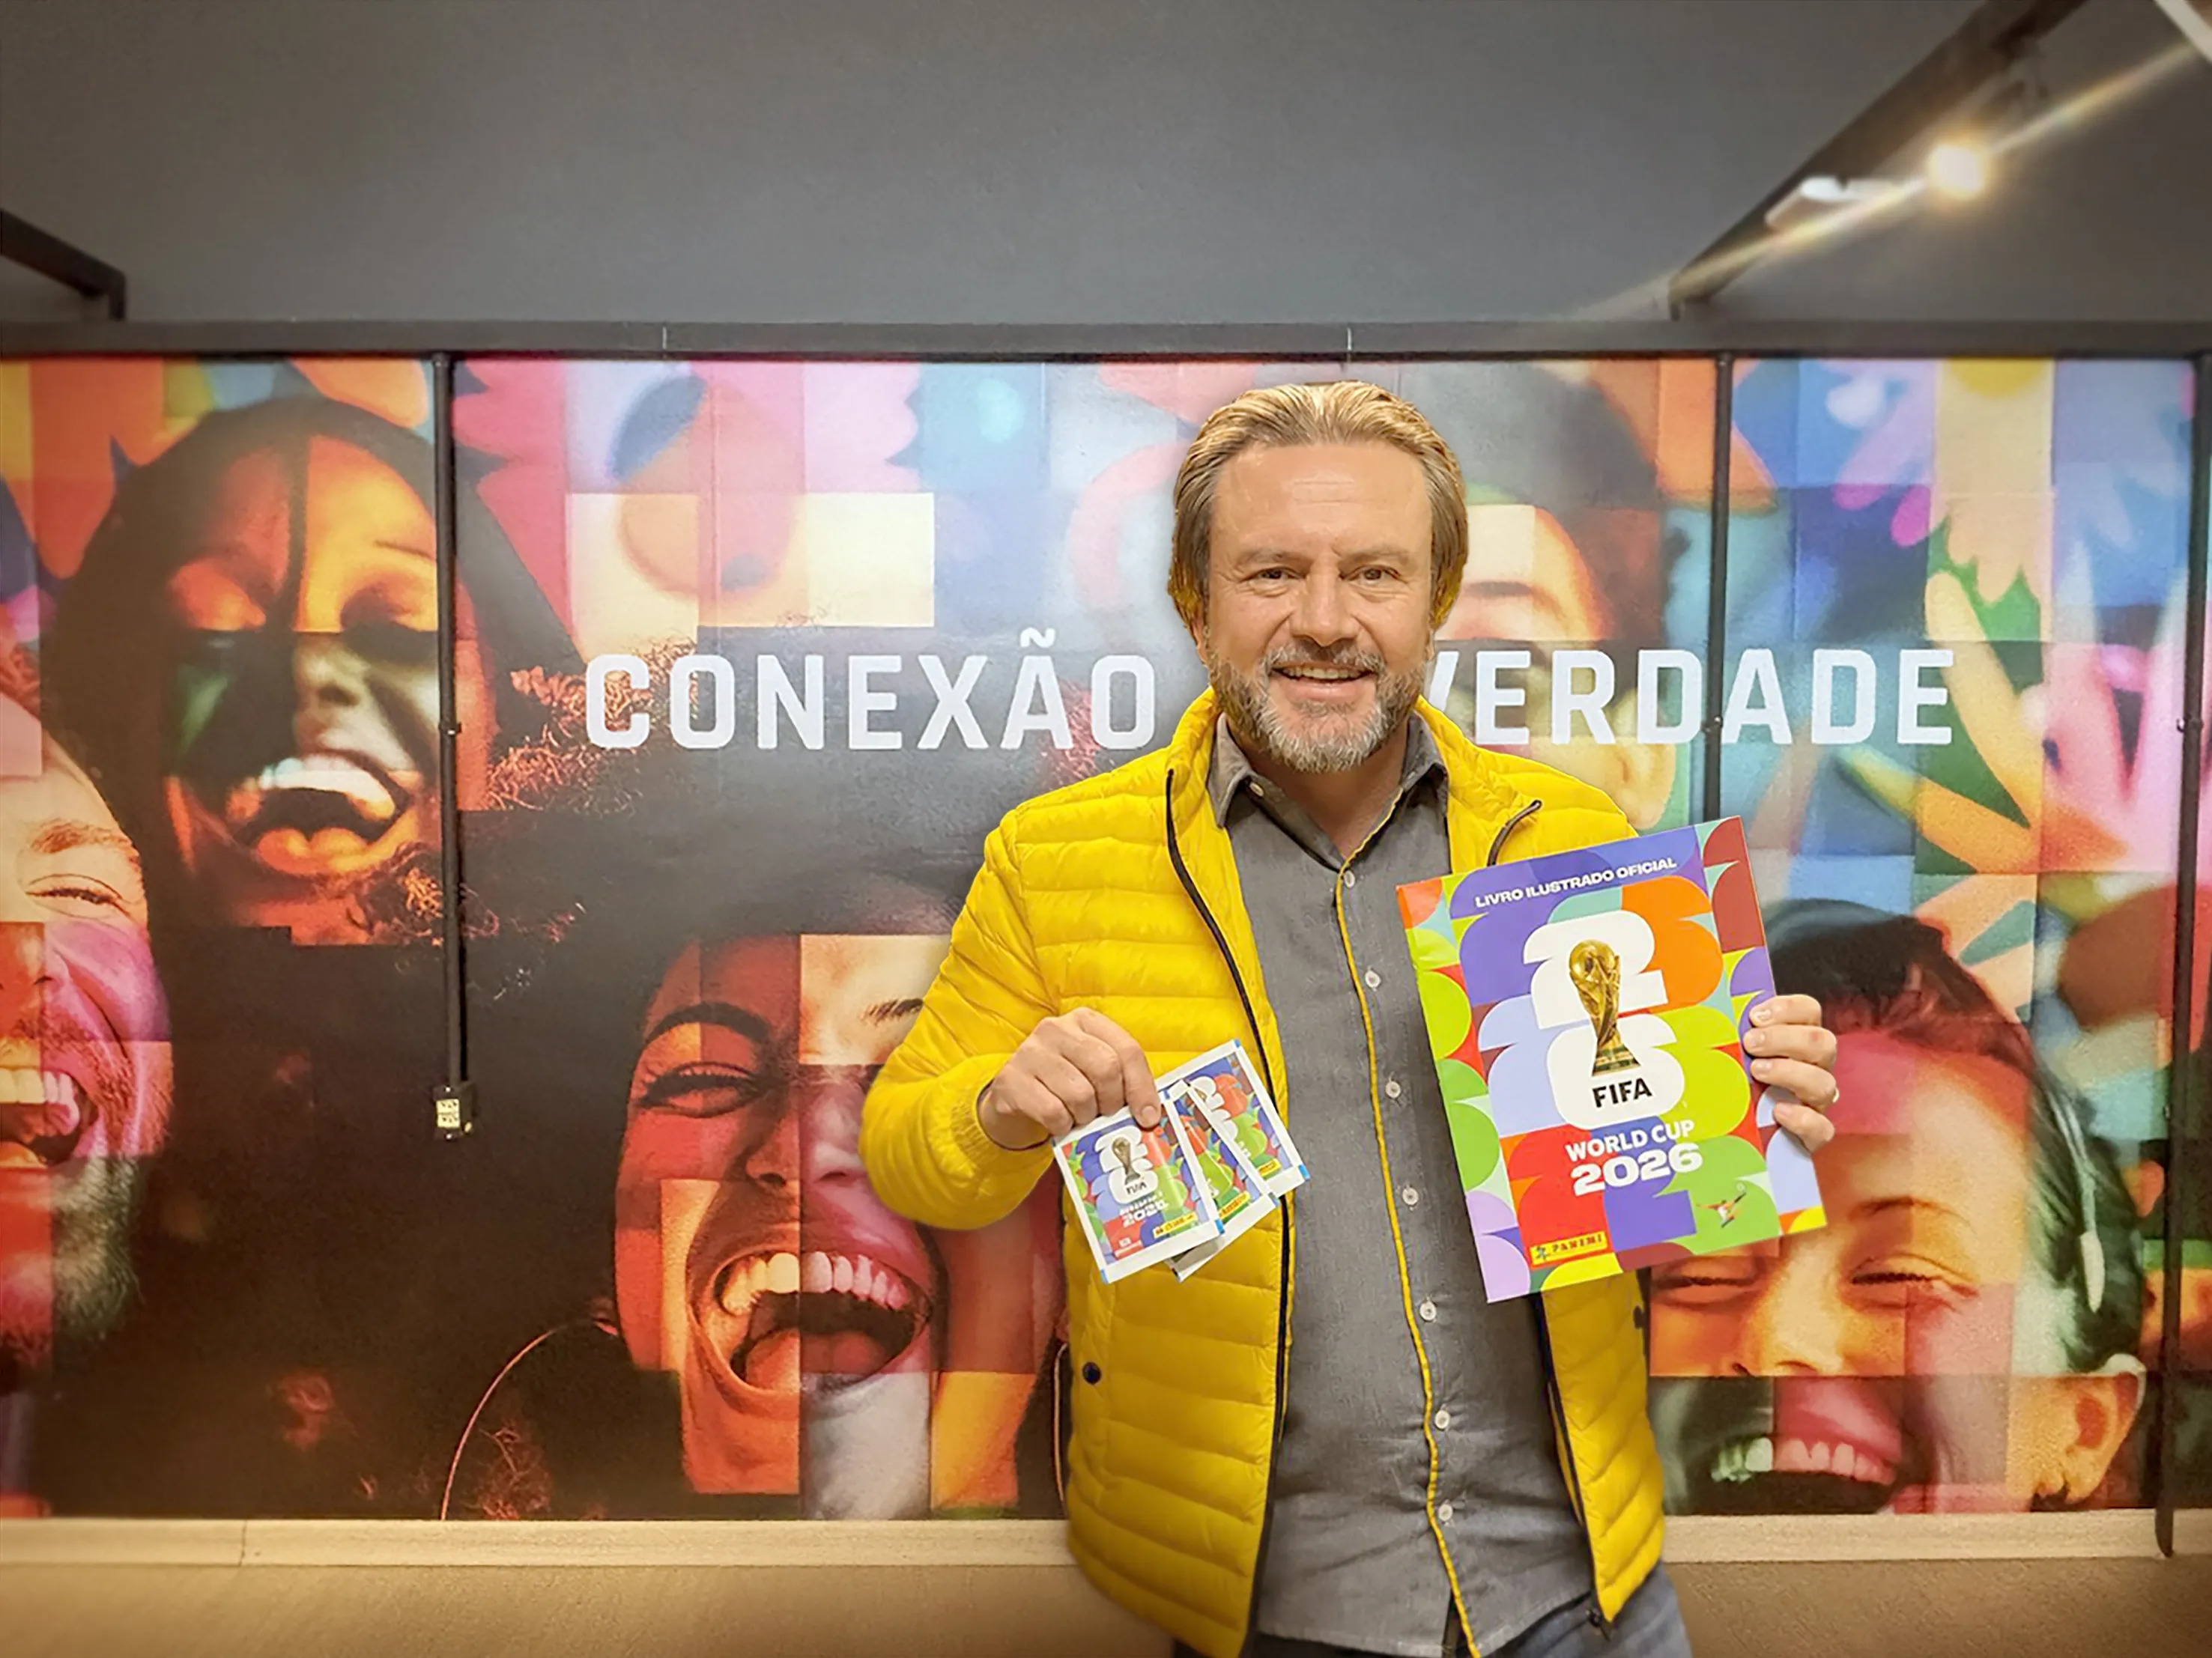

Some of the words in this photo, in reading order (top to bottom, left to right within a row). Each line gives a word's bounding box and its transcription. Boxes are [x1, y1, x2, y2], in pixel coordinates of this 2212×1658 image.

[586, 628, 1156, 750] CONEXÃO
[1475, 888, 1524, 908] LIVRO
[1525, 869, 1614, 898] ILUSTRADO
[1616, 857, 1677, 878] OFICIAL
[1592, 1078, 1652, 1108] FIFA
[1564, 1129, 1648, 1161] WORLD
[1651, 1120, 1695, 1144] CUP
[1571, 1142, 1703, 1197] 2026
[1552, 1233, 1602, 1252] PANINI
